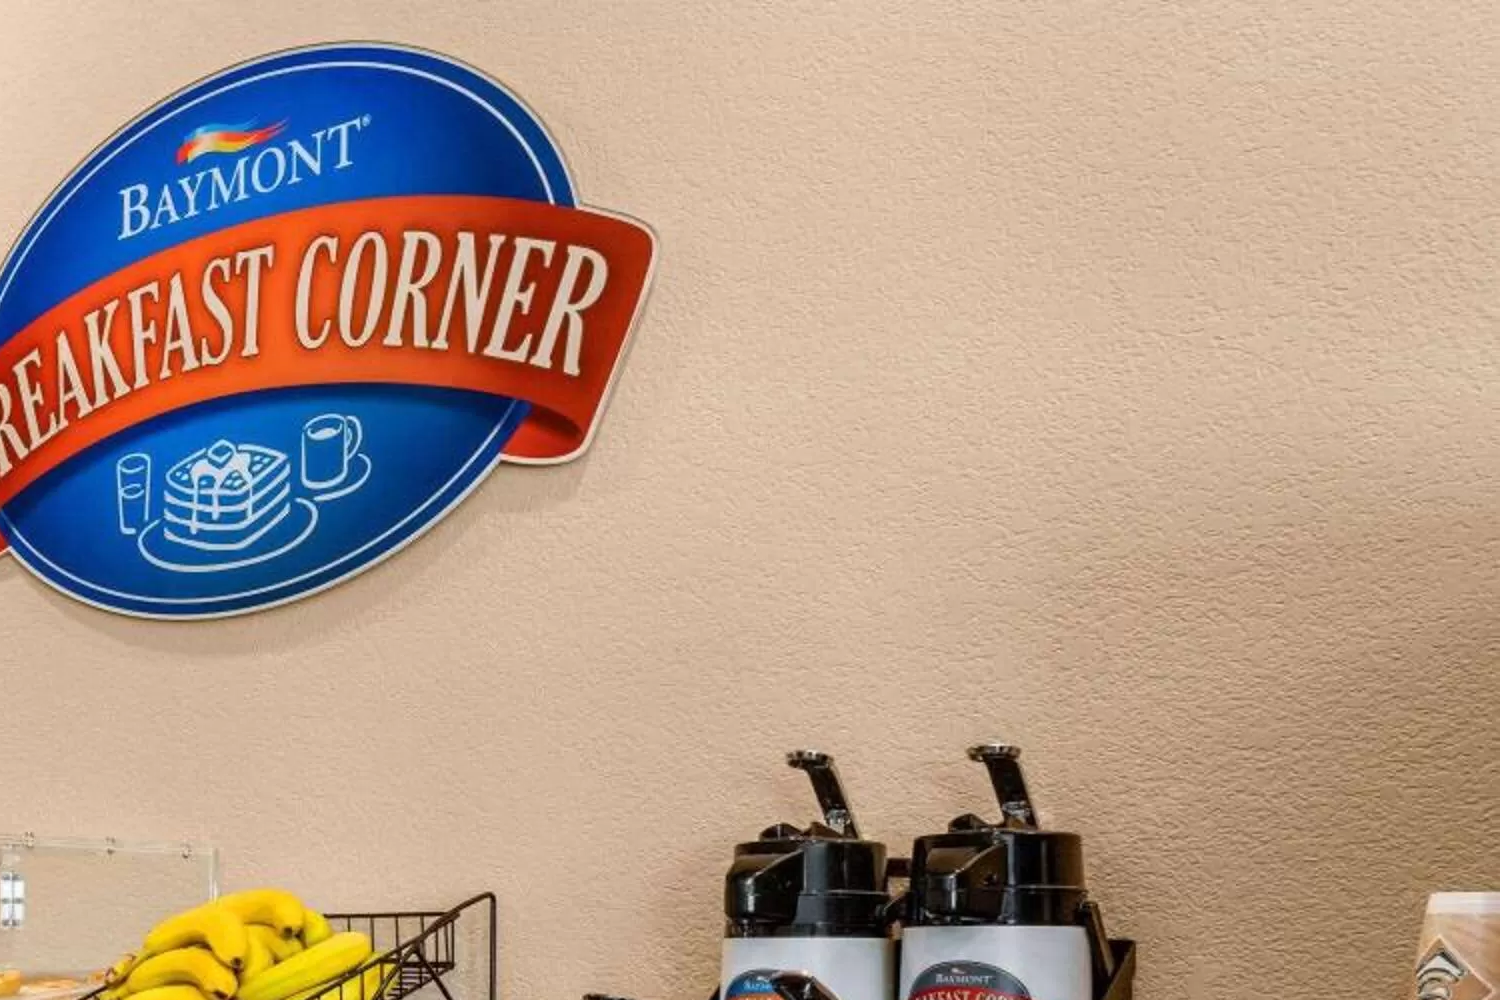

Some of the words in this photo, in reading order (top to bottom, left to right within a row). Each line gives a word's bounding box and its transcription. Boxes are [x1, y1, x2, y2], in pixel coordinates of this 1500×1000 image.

[117, 118, 362, 241] BAYMONT
[294, 230, 609, 378] CORNER
[935, 973, 990, 985] BAYMONT
